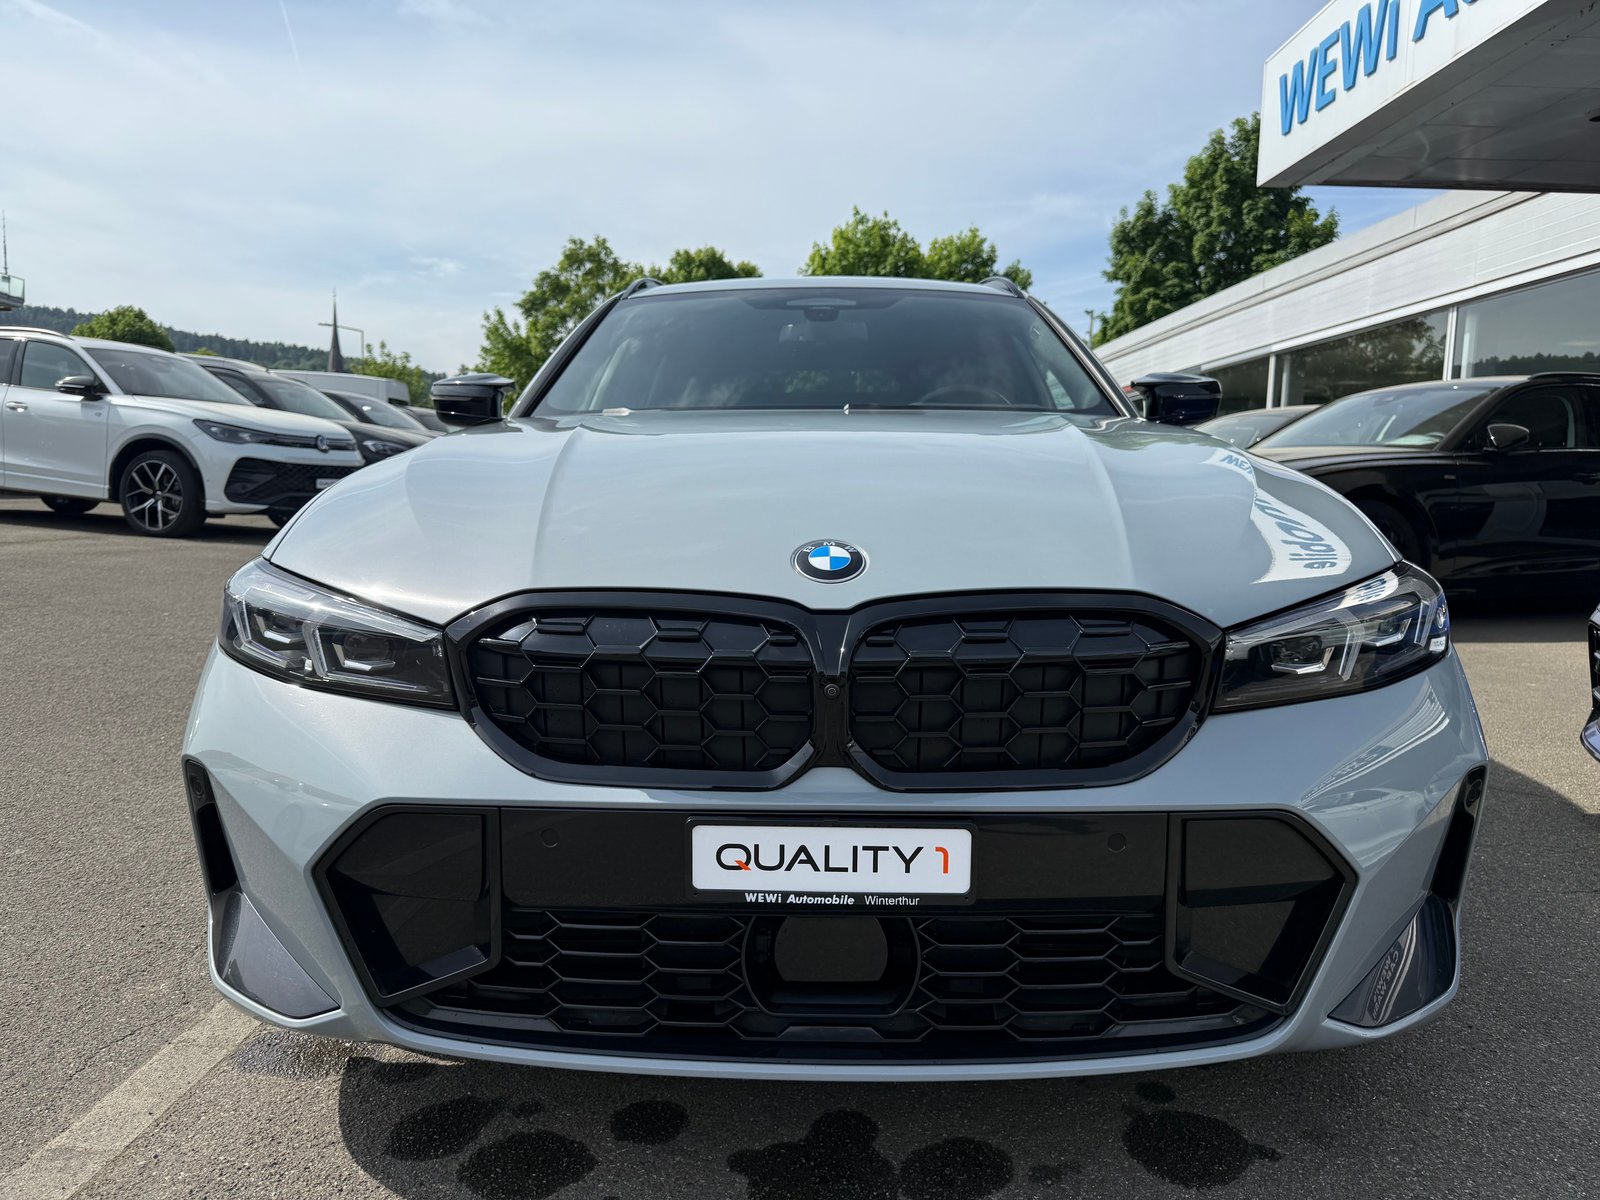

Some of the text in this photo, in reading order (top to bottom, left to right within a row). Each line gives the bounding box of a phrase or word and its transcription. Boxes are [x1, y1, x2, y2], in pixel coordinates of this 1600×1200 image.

[716, 843, 949, 874] QUALITY 1
[786, 893, 855, 906] Automobile
[864, 895, 920, 906] Winterthur
